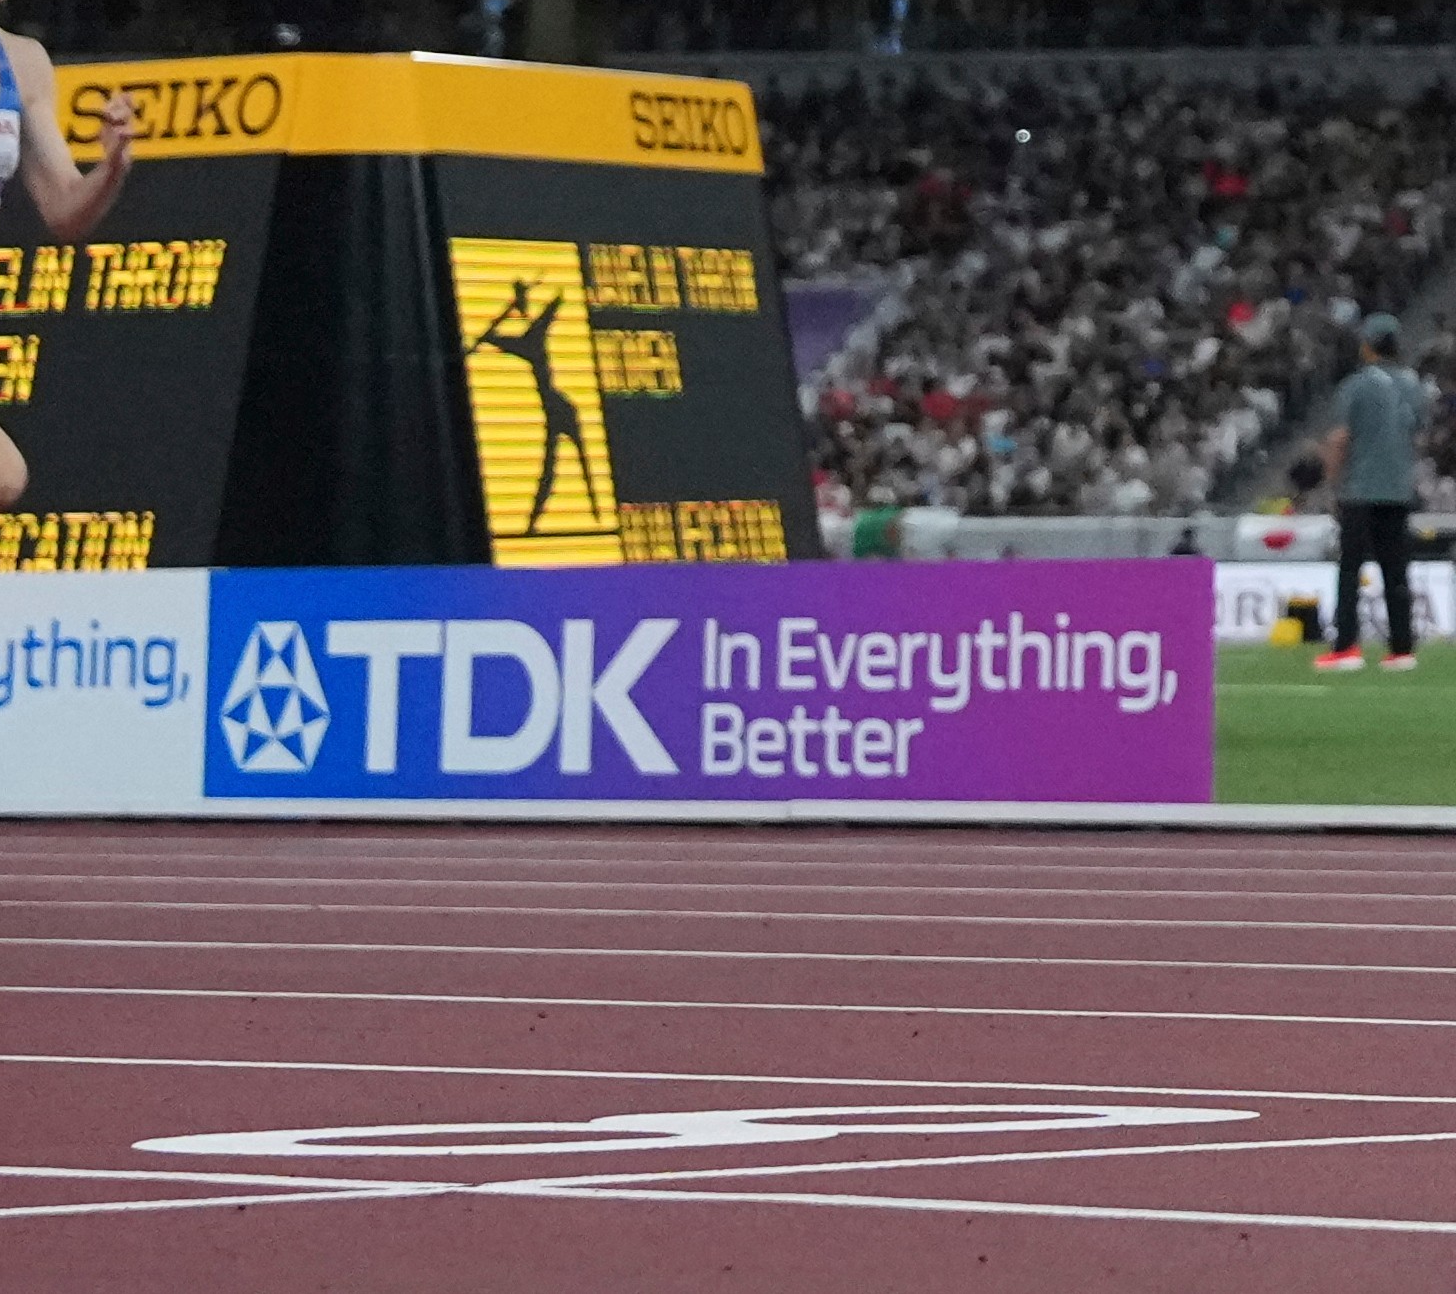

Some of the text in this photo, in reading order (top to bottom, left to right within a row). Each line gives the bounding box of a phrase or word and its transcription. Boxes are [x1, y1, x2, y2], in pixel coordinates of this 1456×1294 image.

[65, 71, 284, 147] SEIKO
[628, 89, 748, 156] SEIKO
[327, 618, 681, 776] TDK
[702, 613, 1179, 713] In Everything,
[701, 701, 924, 778] Better
